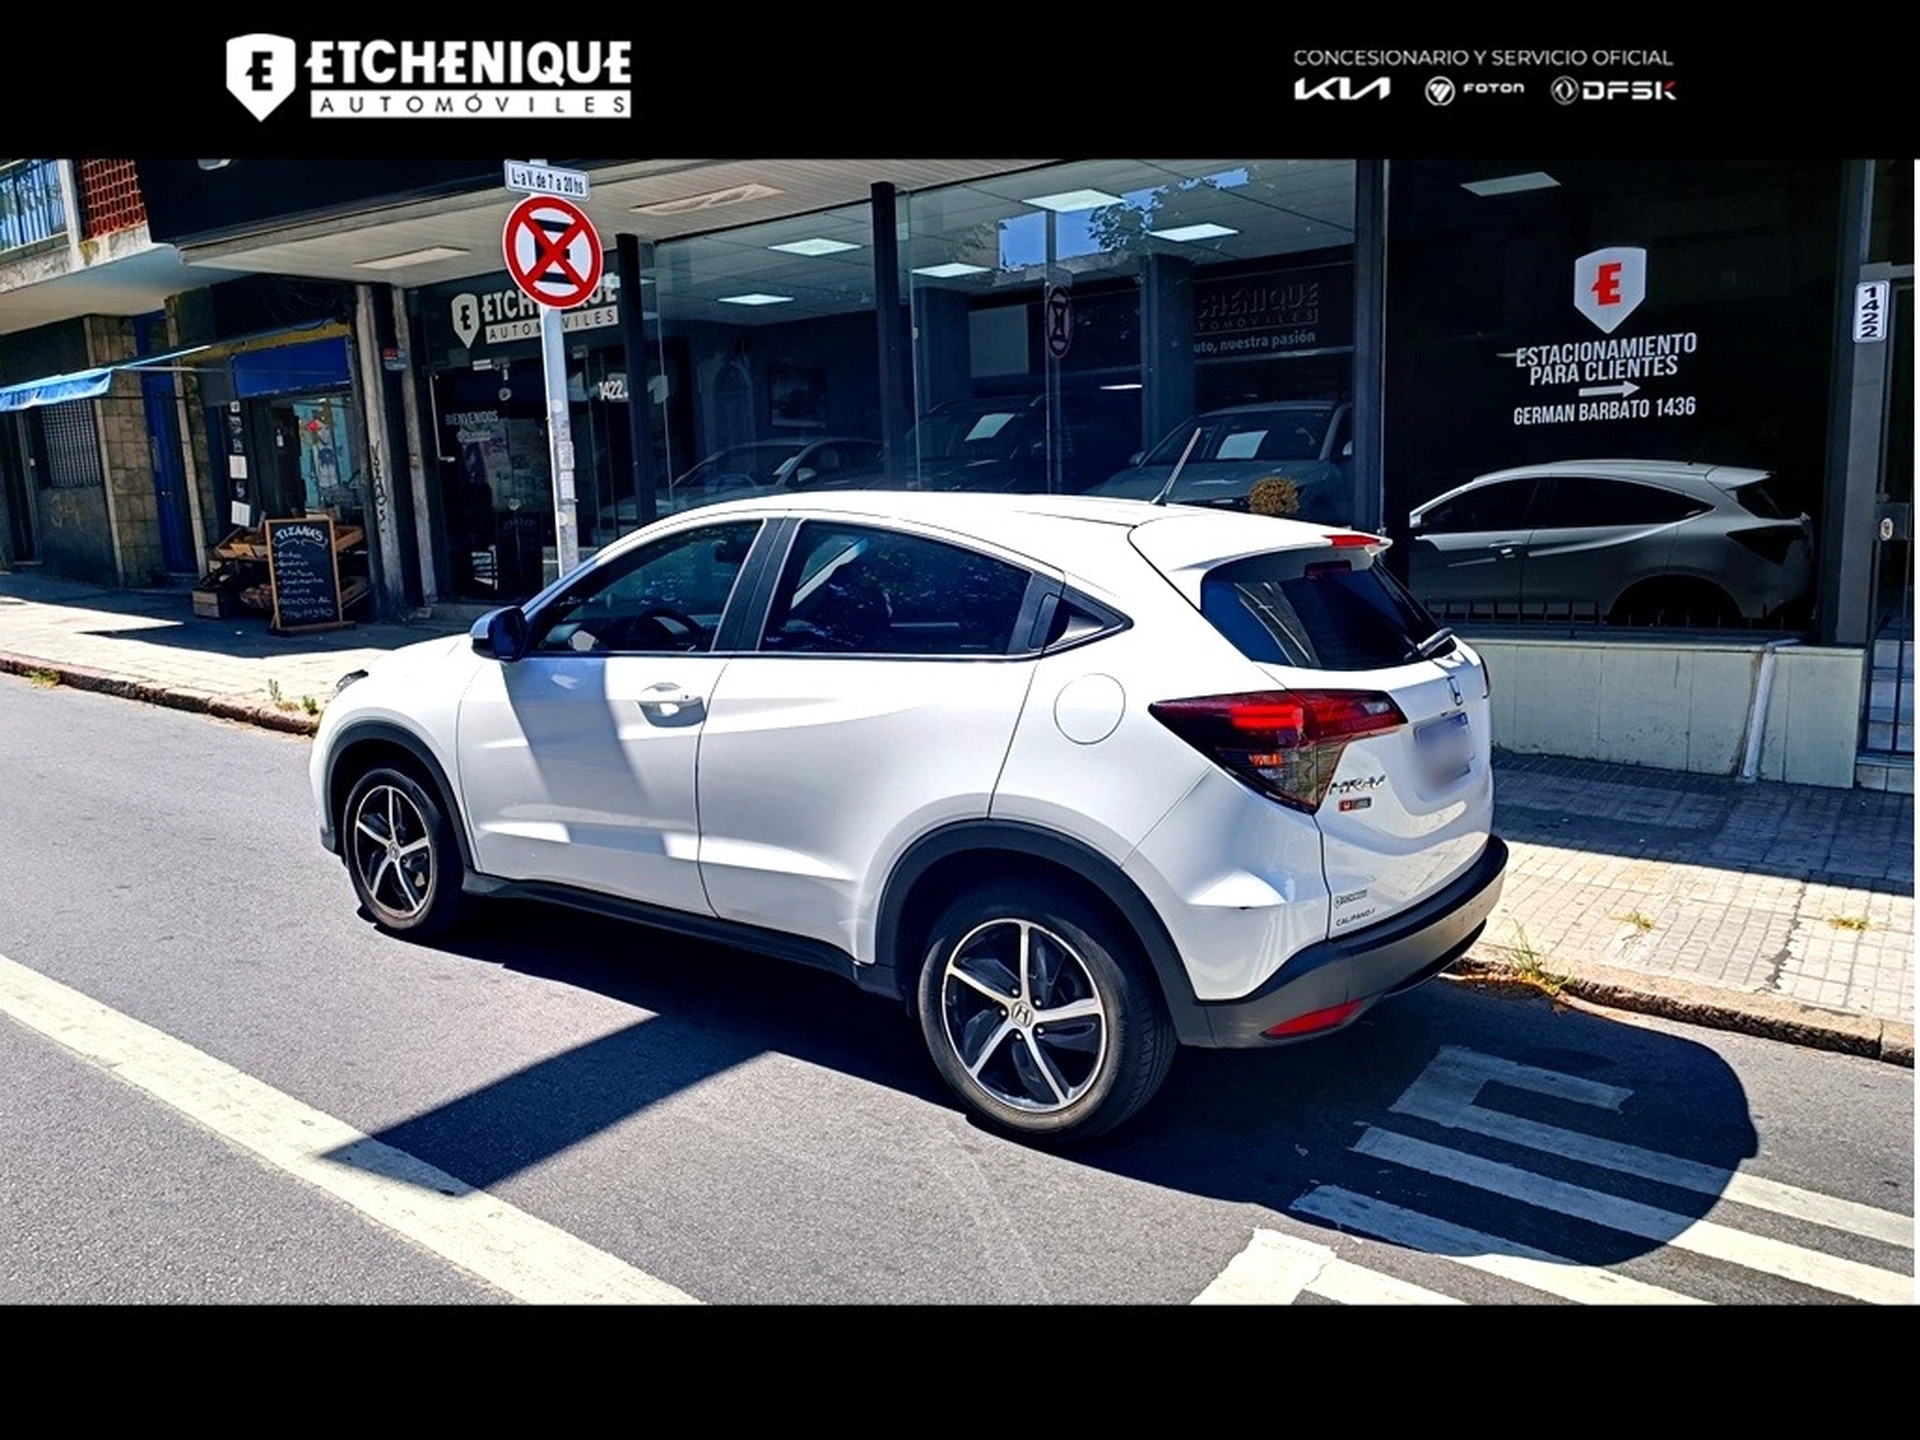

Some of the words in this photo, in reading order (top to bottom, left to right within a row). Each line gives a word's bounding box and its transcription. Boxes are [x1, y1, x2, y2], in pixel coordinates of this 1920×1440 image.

[536, 171, 546, 189] de
[548, 173, 554, 190] 7
[556, 178, 562, 192] a
[564, 175, 573, 193] 20
[574, 176, 584, 195] hs
[482, 285, 617, 323] ETCHUE
[1861, 286, 1880, 338] 1422
[1220, 335, 1269, 351] nuestra
[1271, 329, 1316, 349] pasión
[1516, 331, 1697, 368] ESTACIONAMIENTO
[1530, 364, 1579, 386] PARA
[1584, 354, 1678, 382] CLIENTES
[1513, 404, 1575, 426] GERMAN
[1579, 399, 1650, 422] BARBATO
[1655, 396, 1696, 417] 1436
